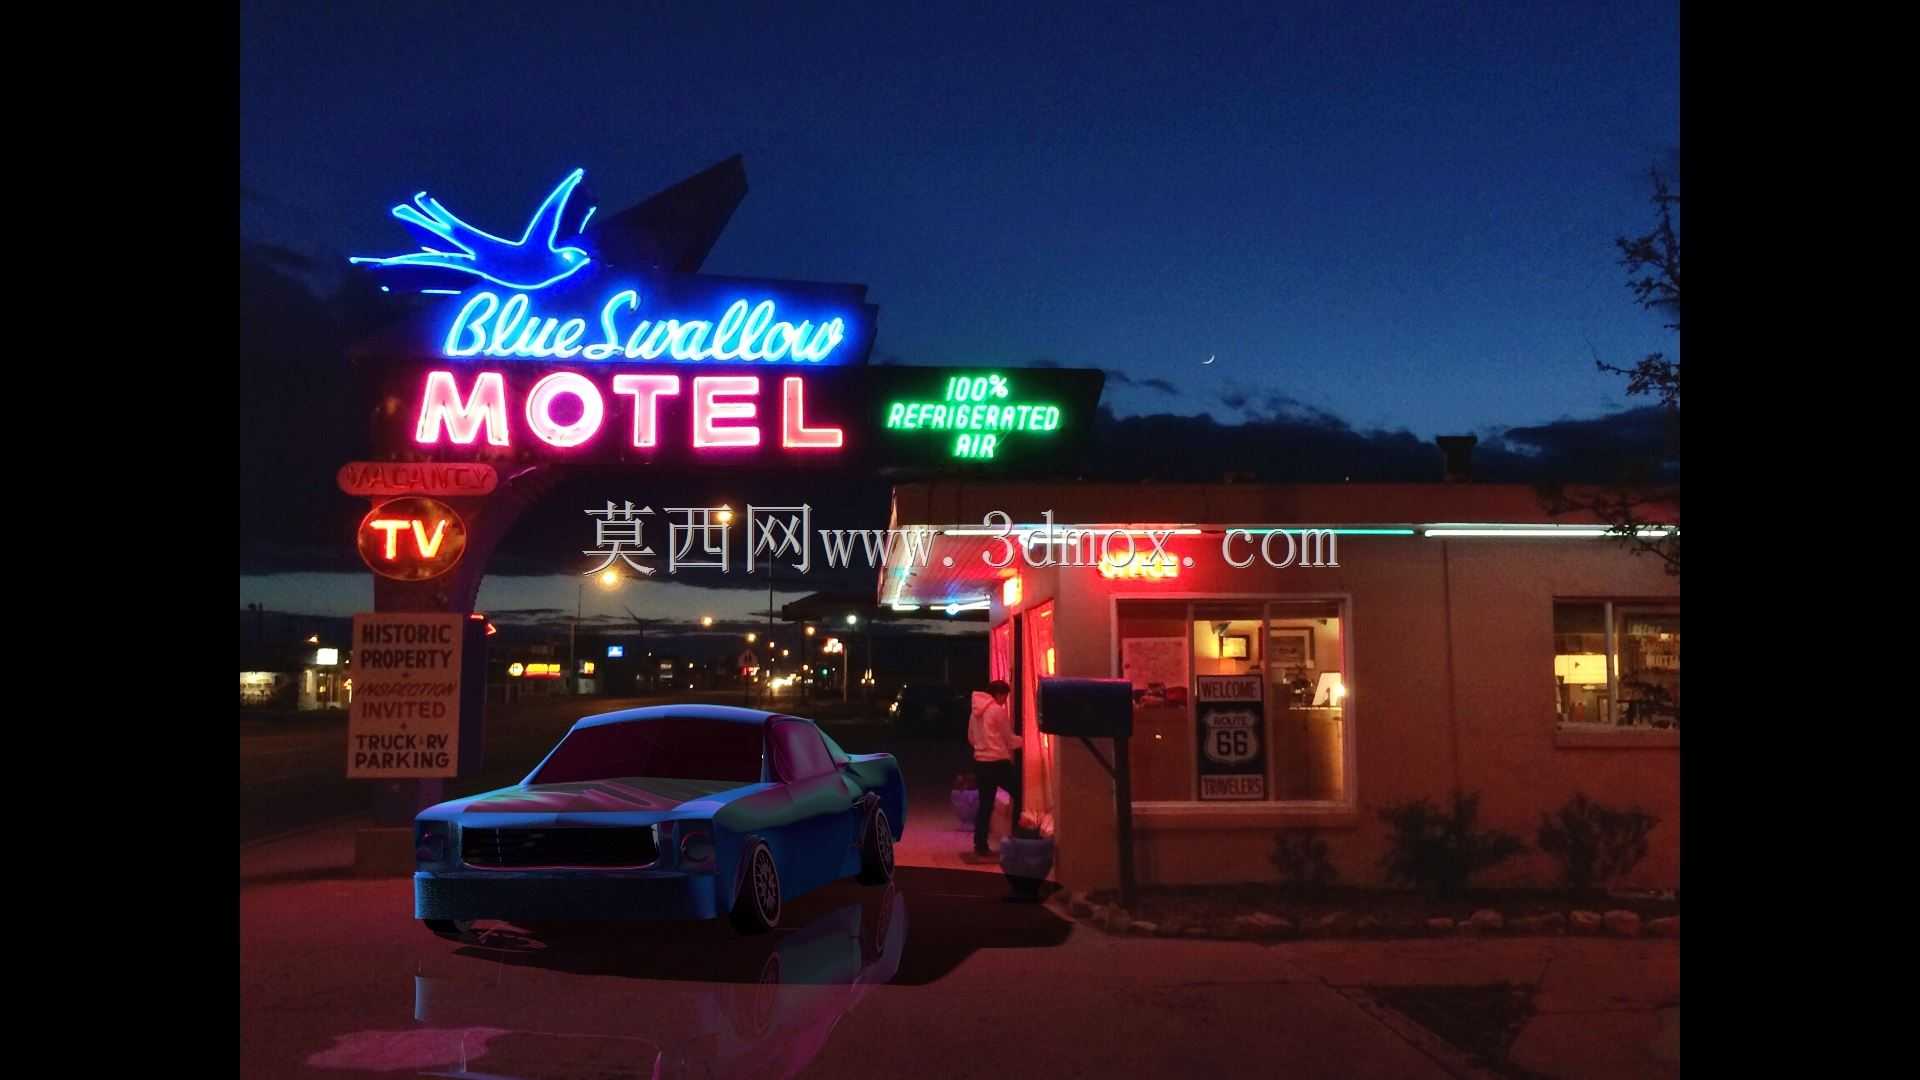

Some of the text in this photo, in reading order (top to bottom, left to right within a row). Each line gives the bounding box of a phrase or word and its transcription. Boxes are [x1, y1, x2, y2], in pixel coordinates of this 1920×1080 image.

[444, 290, 844, 361] Blue Swallow
[946, 374, 1009, 402] 100%
[415, 370, 844, 448] MOTEL
[887, 402, 1060, 431] REFRIGERATED
[954, 433, 997, 459] AIR
[346, 465, 490, 489] VACANCY
[369, 519, 448, 560] TV
[361, 624, 452, 643] HISTORIC
[360, 649, 453, 668] PROPERTY
[356, 682, 457, 697] INSPECTION
[1201, 681, 1258, 699] WELCOME
[361, 702, 446, 719] INVITED
[1213, 716, 1249, 726] ROUTE
[355, 734, 449, 750] TRUCK RV
[1216, 731, 1248, 756] 66
[355, 752, 449, 769] PARKING
[1204, 777, 1262, 795] TRAVELERS
